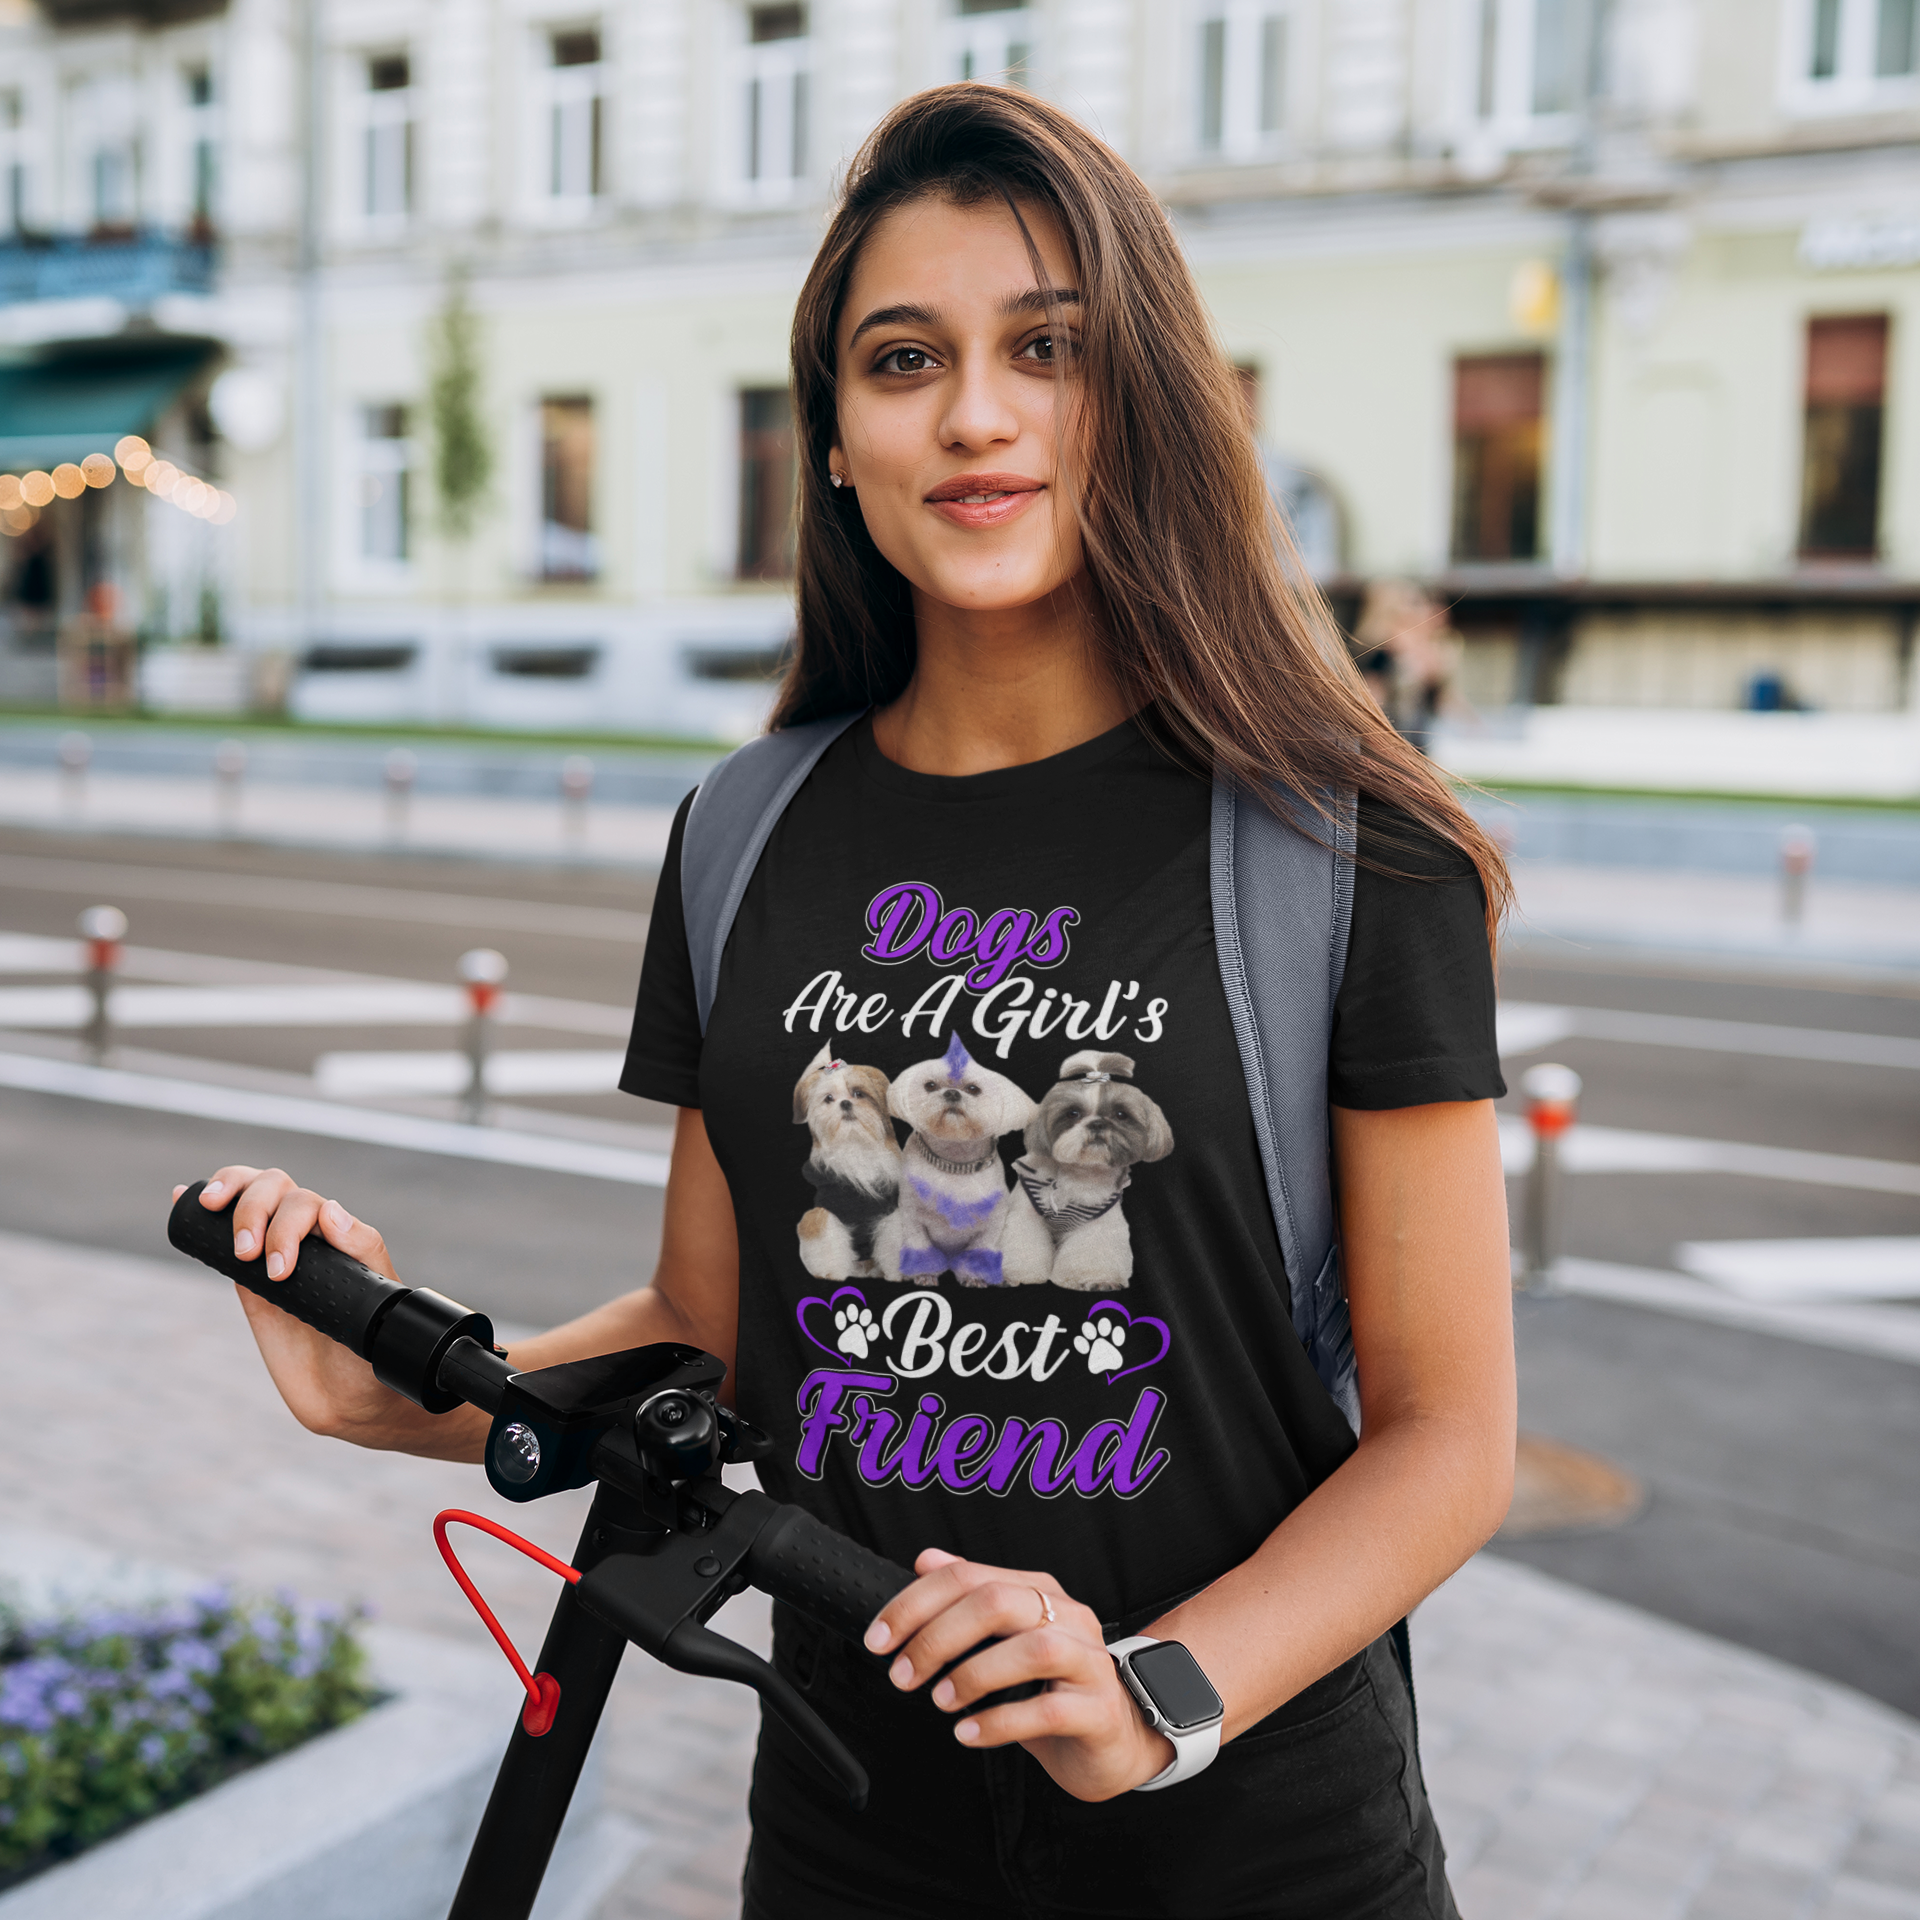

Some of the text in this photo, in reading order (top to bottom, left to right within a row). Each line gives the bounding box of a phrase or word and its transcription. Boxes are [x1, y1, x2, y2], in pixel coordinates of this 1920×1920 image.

[861, 881, 1081, 995] Dogs
[783, 971, 1169, 1059] Are A Girl's
[882, 1291, 1070, 1382] Best
[796, 1367, 1170, 1500] Friend
